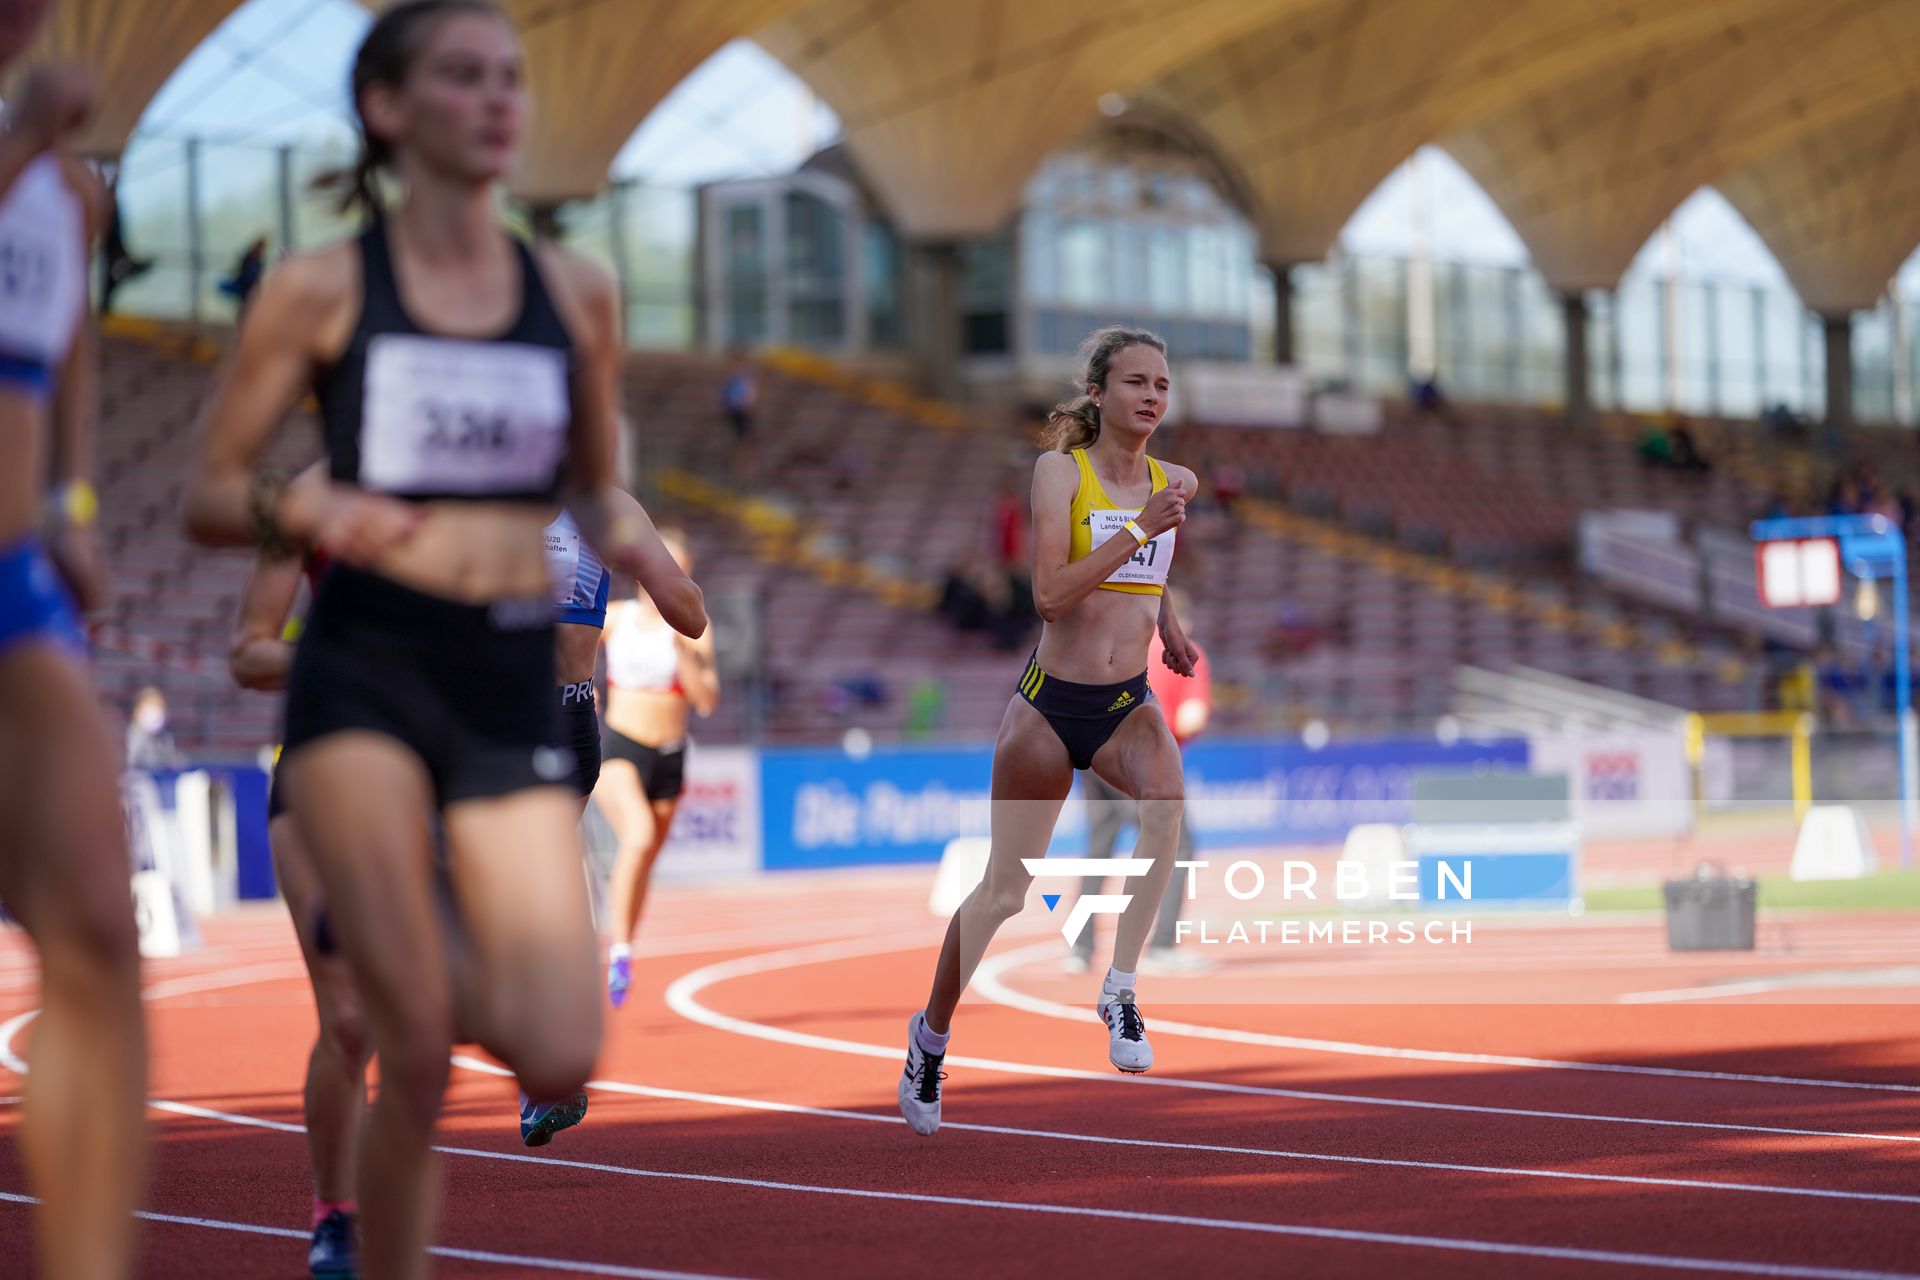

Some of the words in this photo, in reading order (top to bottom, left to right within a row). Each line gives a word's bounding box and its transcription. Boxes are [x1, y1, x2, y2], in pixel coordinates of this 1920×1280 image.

[545, 545, 567, 553] haften
[1124, 540, 1157, 567] 47
[1118, 572, 1145, 580] OLDENBURG
[1108, 696, 1136, 712] adidas
